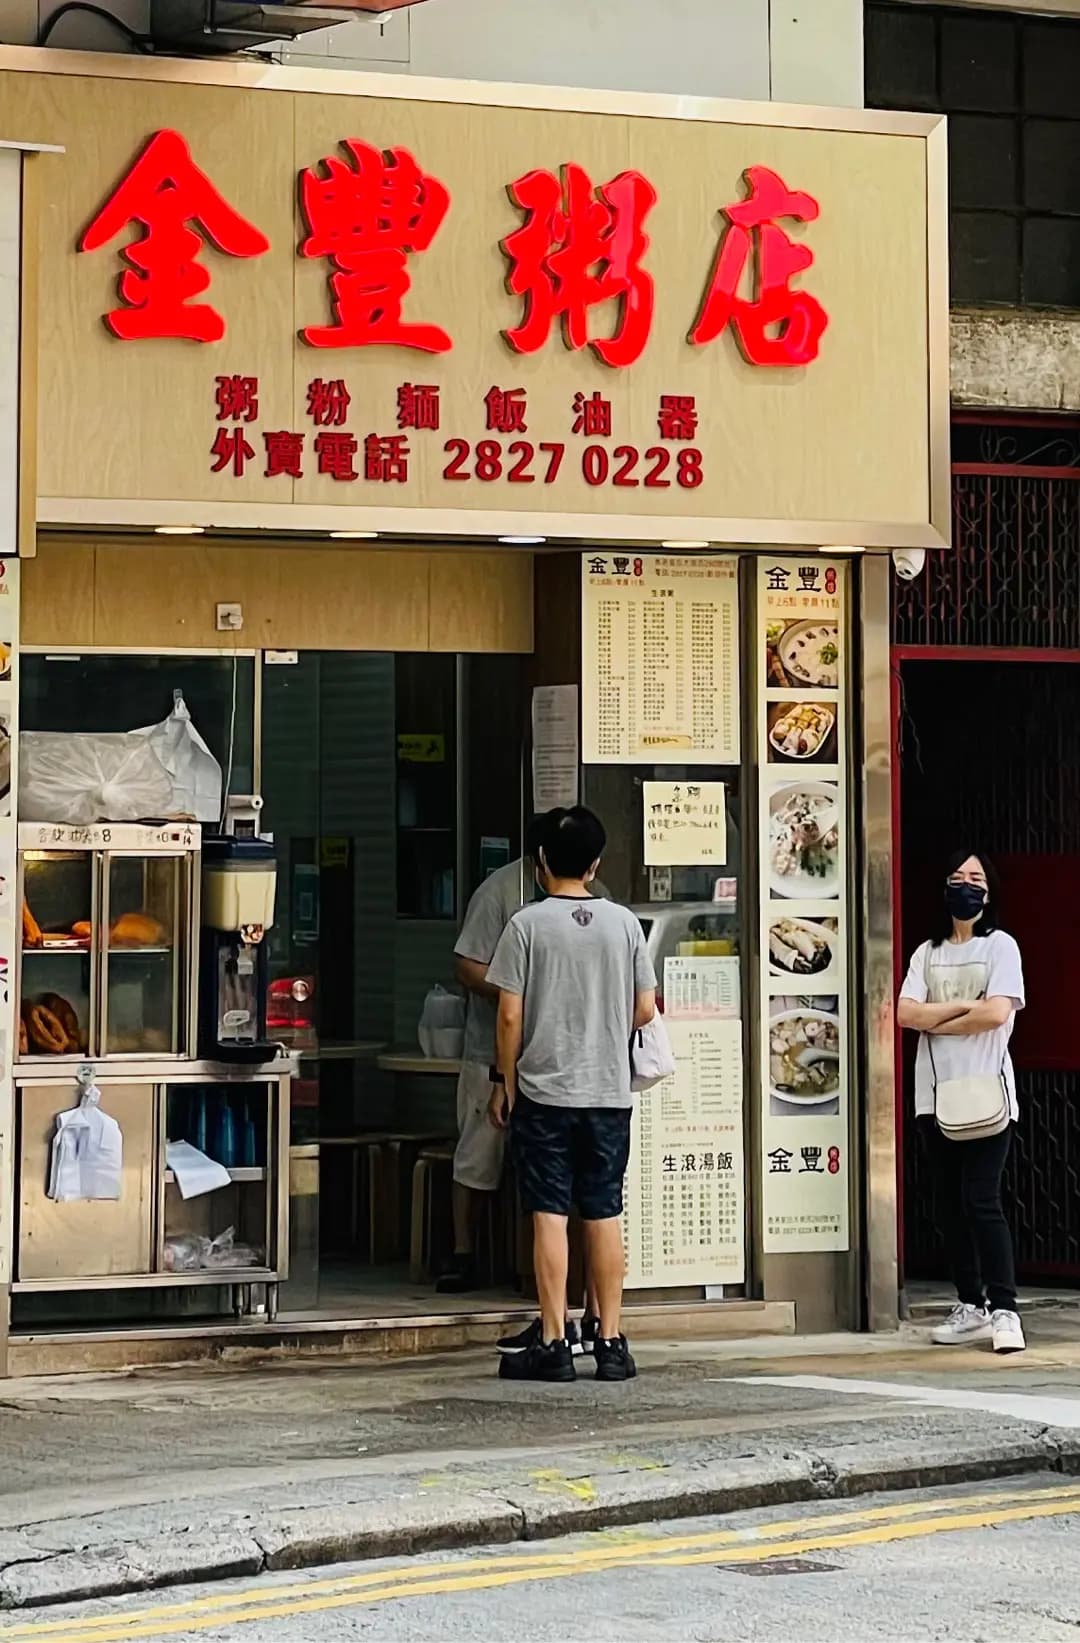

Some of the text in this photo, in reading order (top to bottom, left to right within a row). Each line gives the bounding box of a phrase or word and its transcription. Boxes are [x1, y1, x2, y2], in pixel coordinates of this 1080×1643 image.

[77, 128, 829, 367] 金豐粥店
[215, 375, 698, 440] 粥粉麵飯油器
[210, 426, 704, 488] 外賣電話 2827 0228
[587, 556, 632, 576] 金豐
[764, 566, 822, 593] 金豐
[767, 1146, 825, 1174] 金豐
